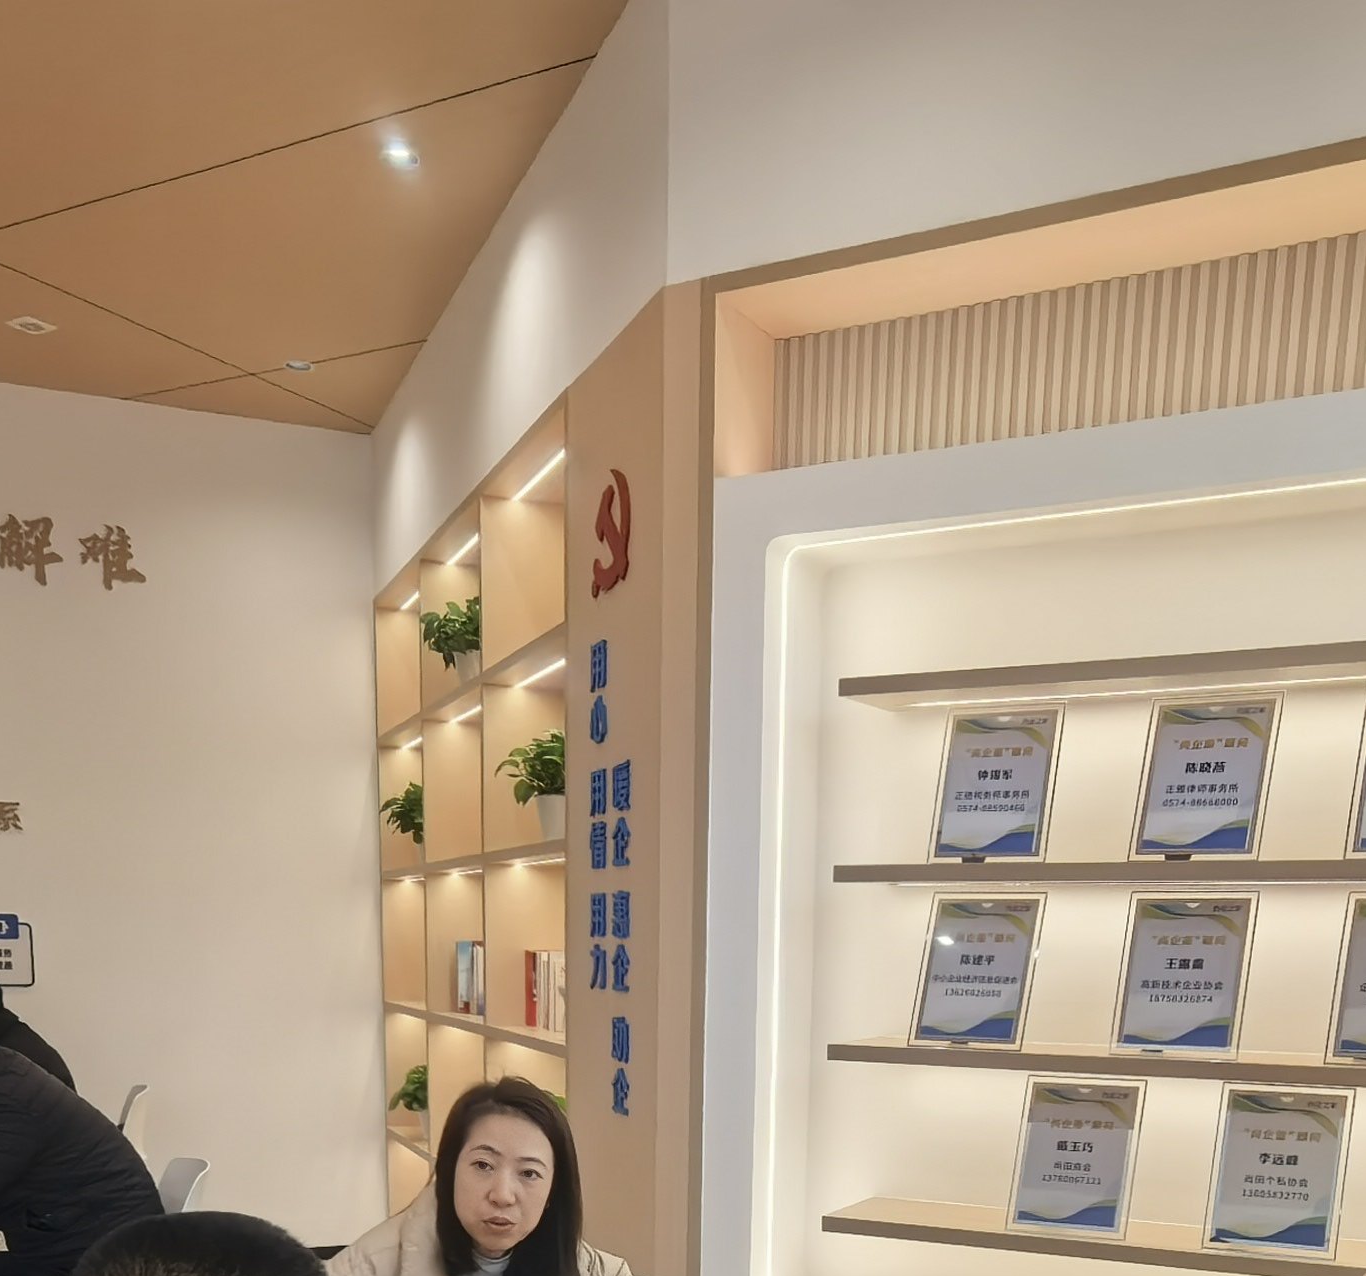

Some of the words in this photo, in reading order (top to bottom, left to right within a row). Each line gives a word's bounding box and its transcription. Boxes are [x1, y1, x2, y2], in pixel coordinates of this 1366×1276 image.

[590, 639, 608, 745] 用心
[589, 768, 607, 869] 用情
[589, 892, 607, 990] 用力
